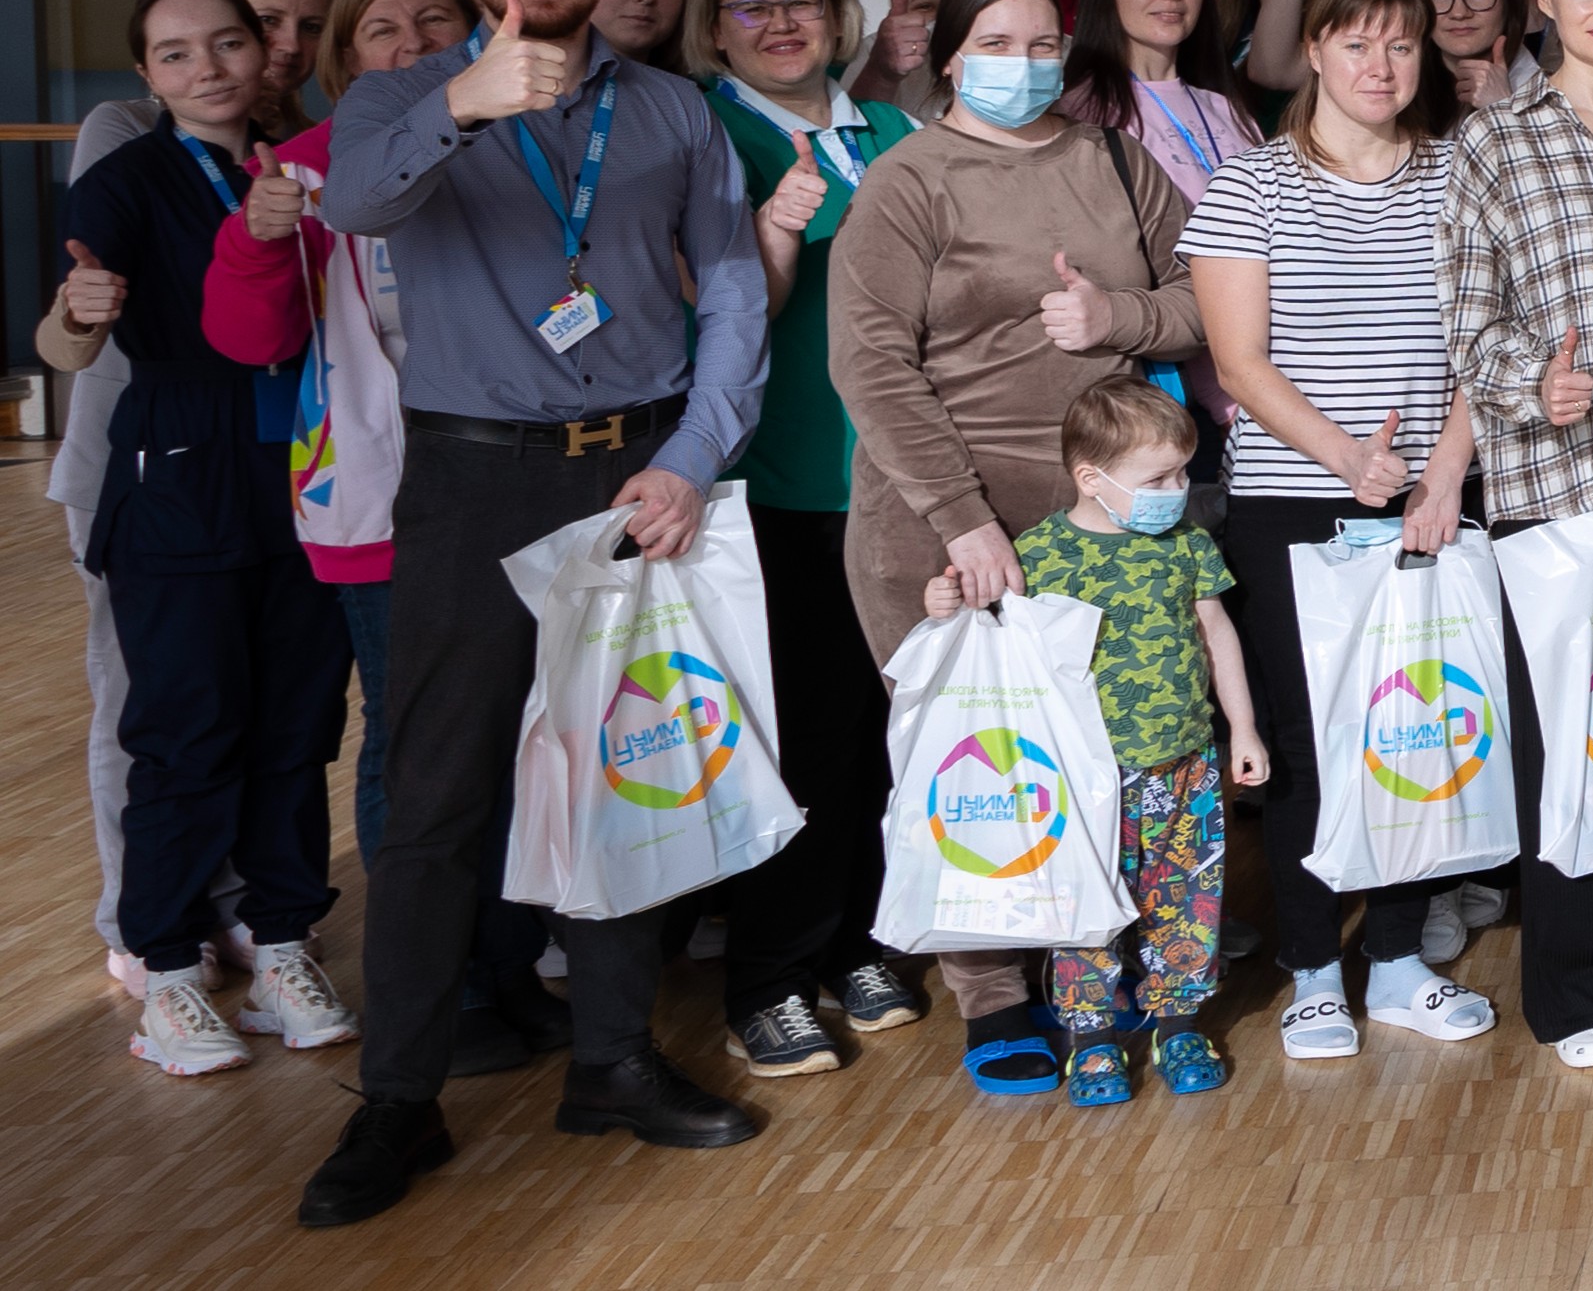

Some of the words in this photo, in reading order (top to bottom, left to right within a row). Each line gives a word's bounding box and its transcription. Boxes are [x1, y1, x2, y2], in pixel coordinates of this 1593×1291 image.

[614, 718, 683, 767] УЧИМ
[636, 735, 686, 760] ЗНАЕМ
[1378, 722, 1444, 754] УЧИМ
[945, 794, 1015, 823] УЧИМ
[962, 808, 1015, 822] ЗНАЕМ
